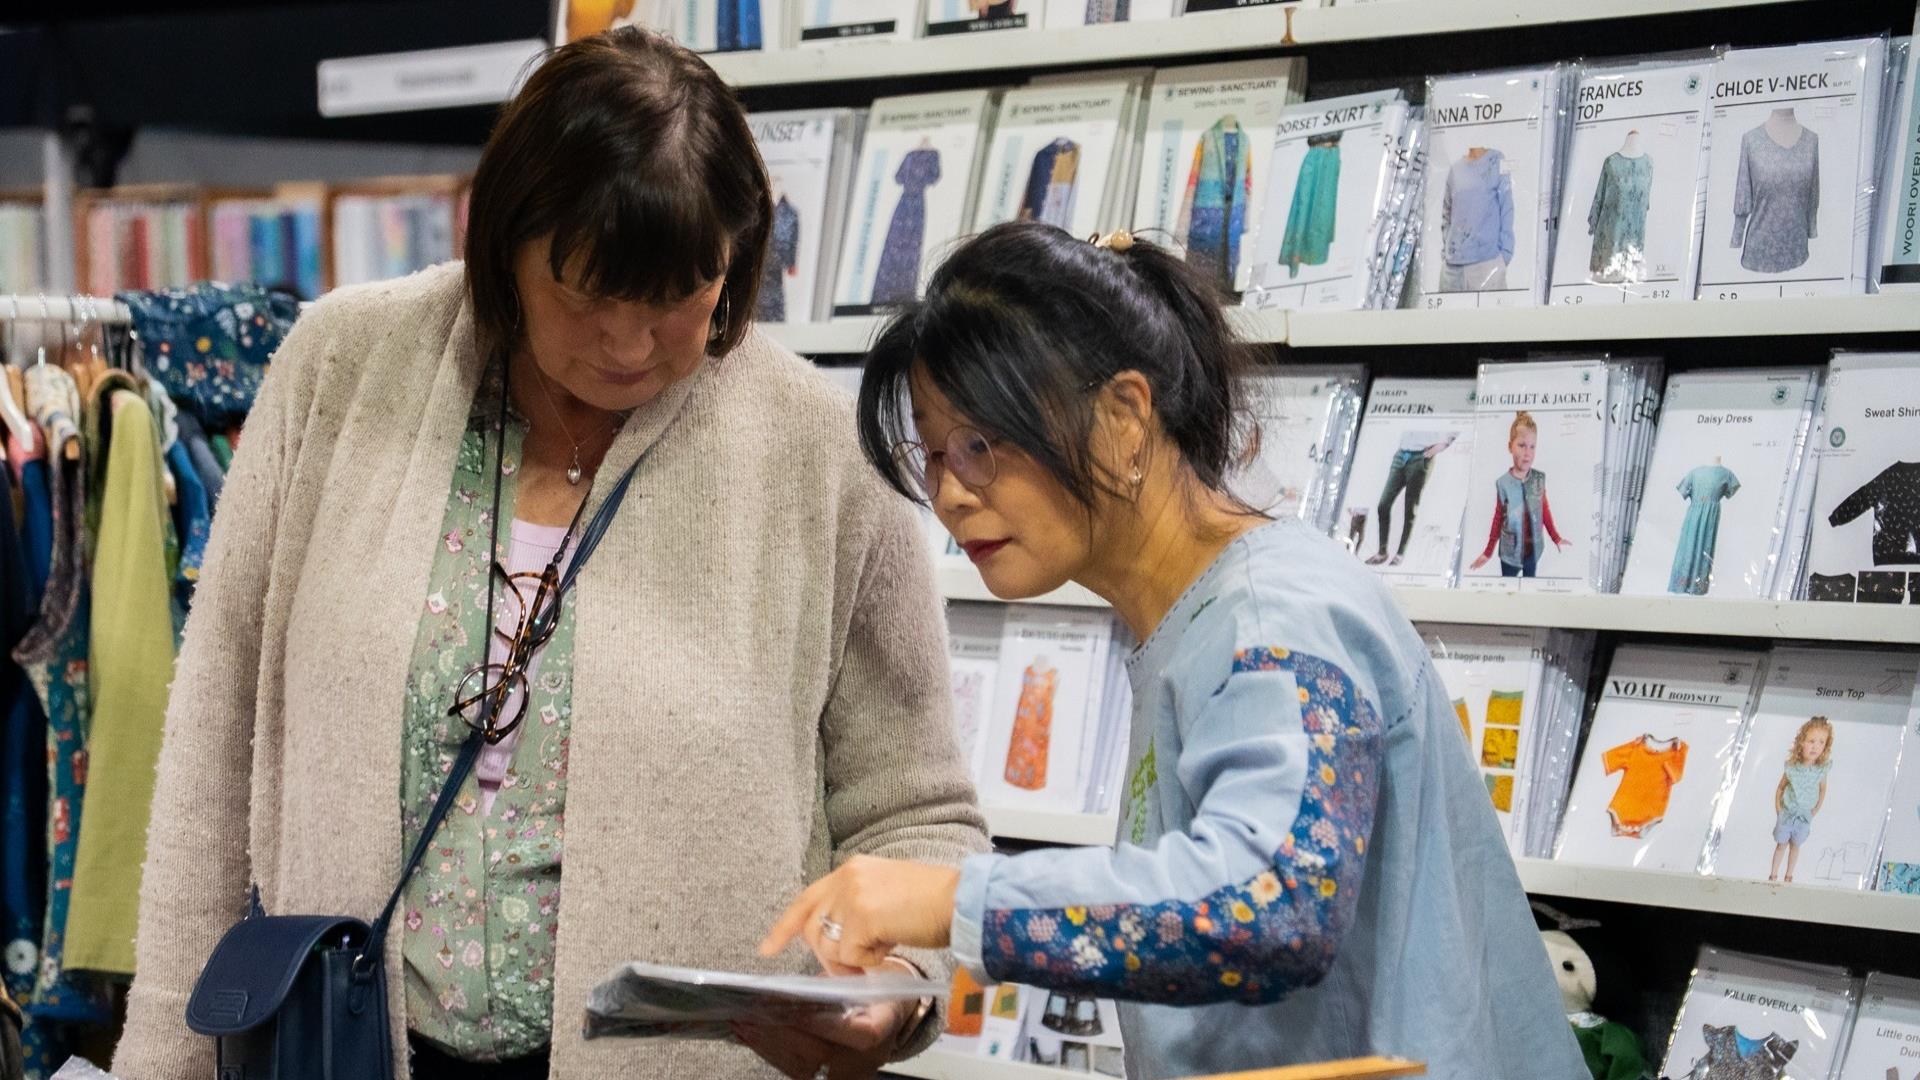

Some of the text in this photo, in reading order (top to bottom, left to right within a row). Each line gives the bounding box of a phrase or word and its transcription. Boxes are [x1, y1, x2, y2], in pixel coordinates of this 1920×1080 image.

[1178, 80, 1277, 96] SEWING SANCTUARY
[1579, 80, 1644, 102] FRANCES
[1715, 72, 1829, 98] CHLOE V-NECK
[1475, 103, 1503, 121] TOP
[1577, 103, 1604, 121] TOP
[1277, 105, 1369, 137] DORSET SKIRT
[1902, 201, 1917, 256] WOORI
[1652, 289, 1670, 299] 8-12
[1499, 392, 1539, 406] GILLET
[1541, 392, 1549, 404] &
[1552, 392, 1592, 405] JACKET
[1370, 403, 1434, 415] JOGGERS
[1864, 407, 1895, 419] Sweat
[1697, 413, 1753, 426] Daisy Dress
[1612, 680, 1722, 704] NOAH BODYSUIT
[1815, 686, 1865, 700] Siena Top
[1876, 1027, 1920, 1043] Little on
